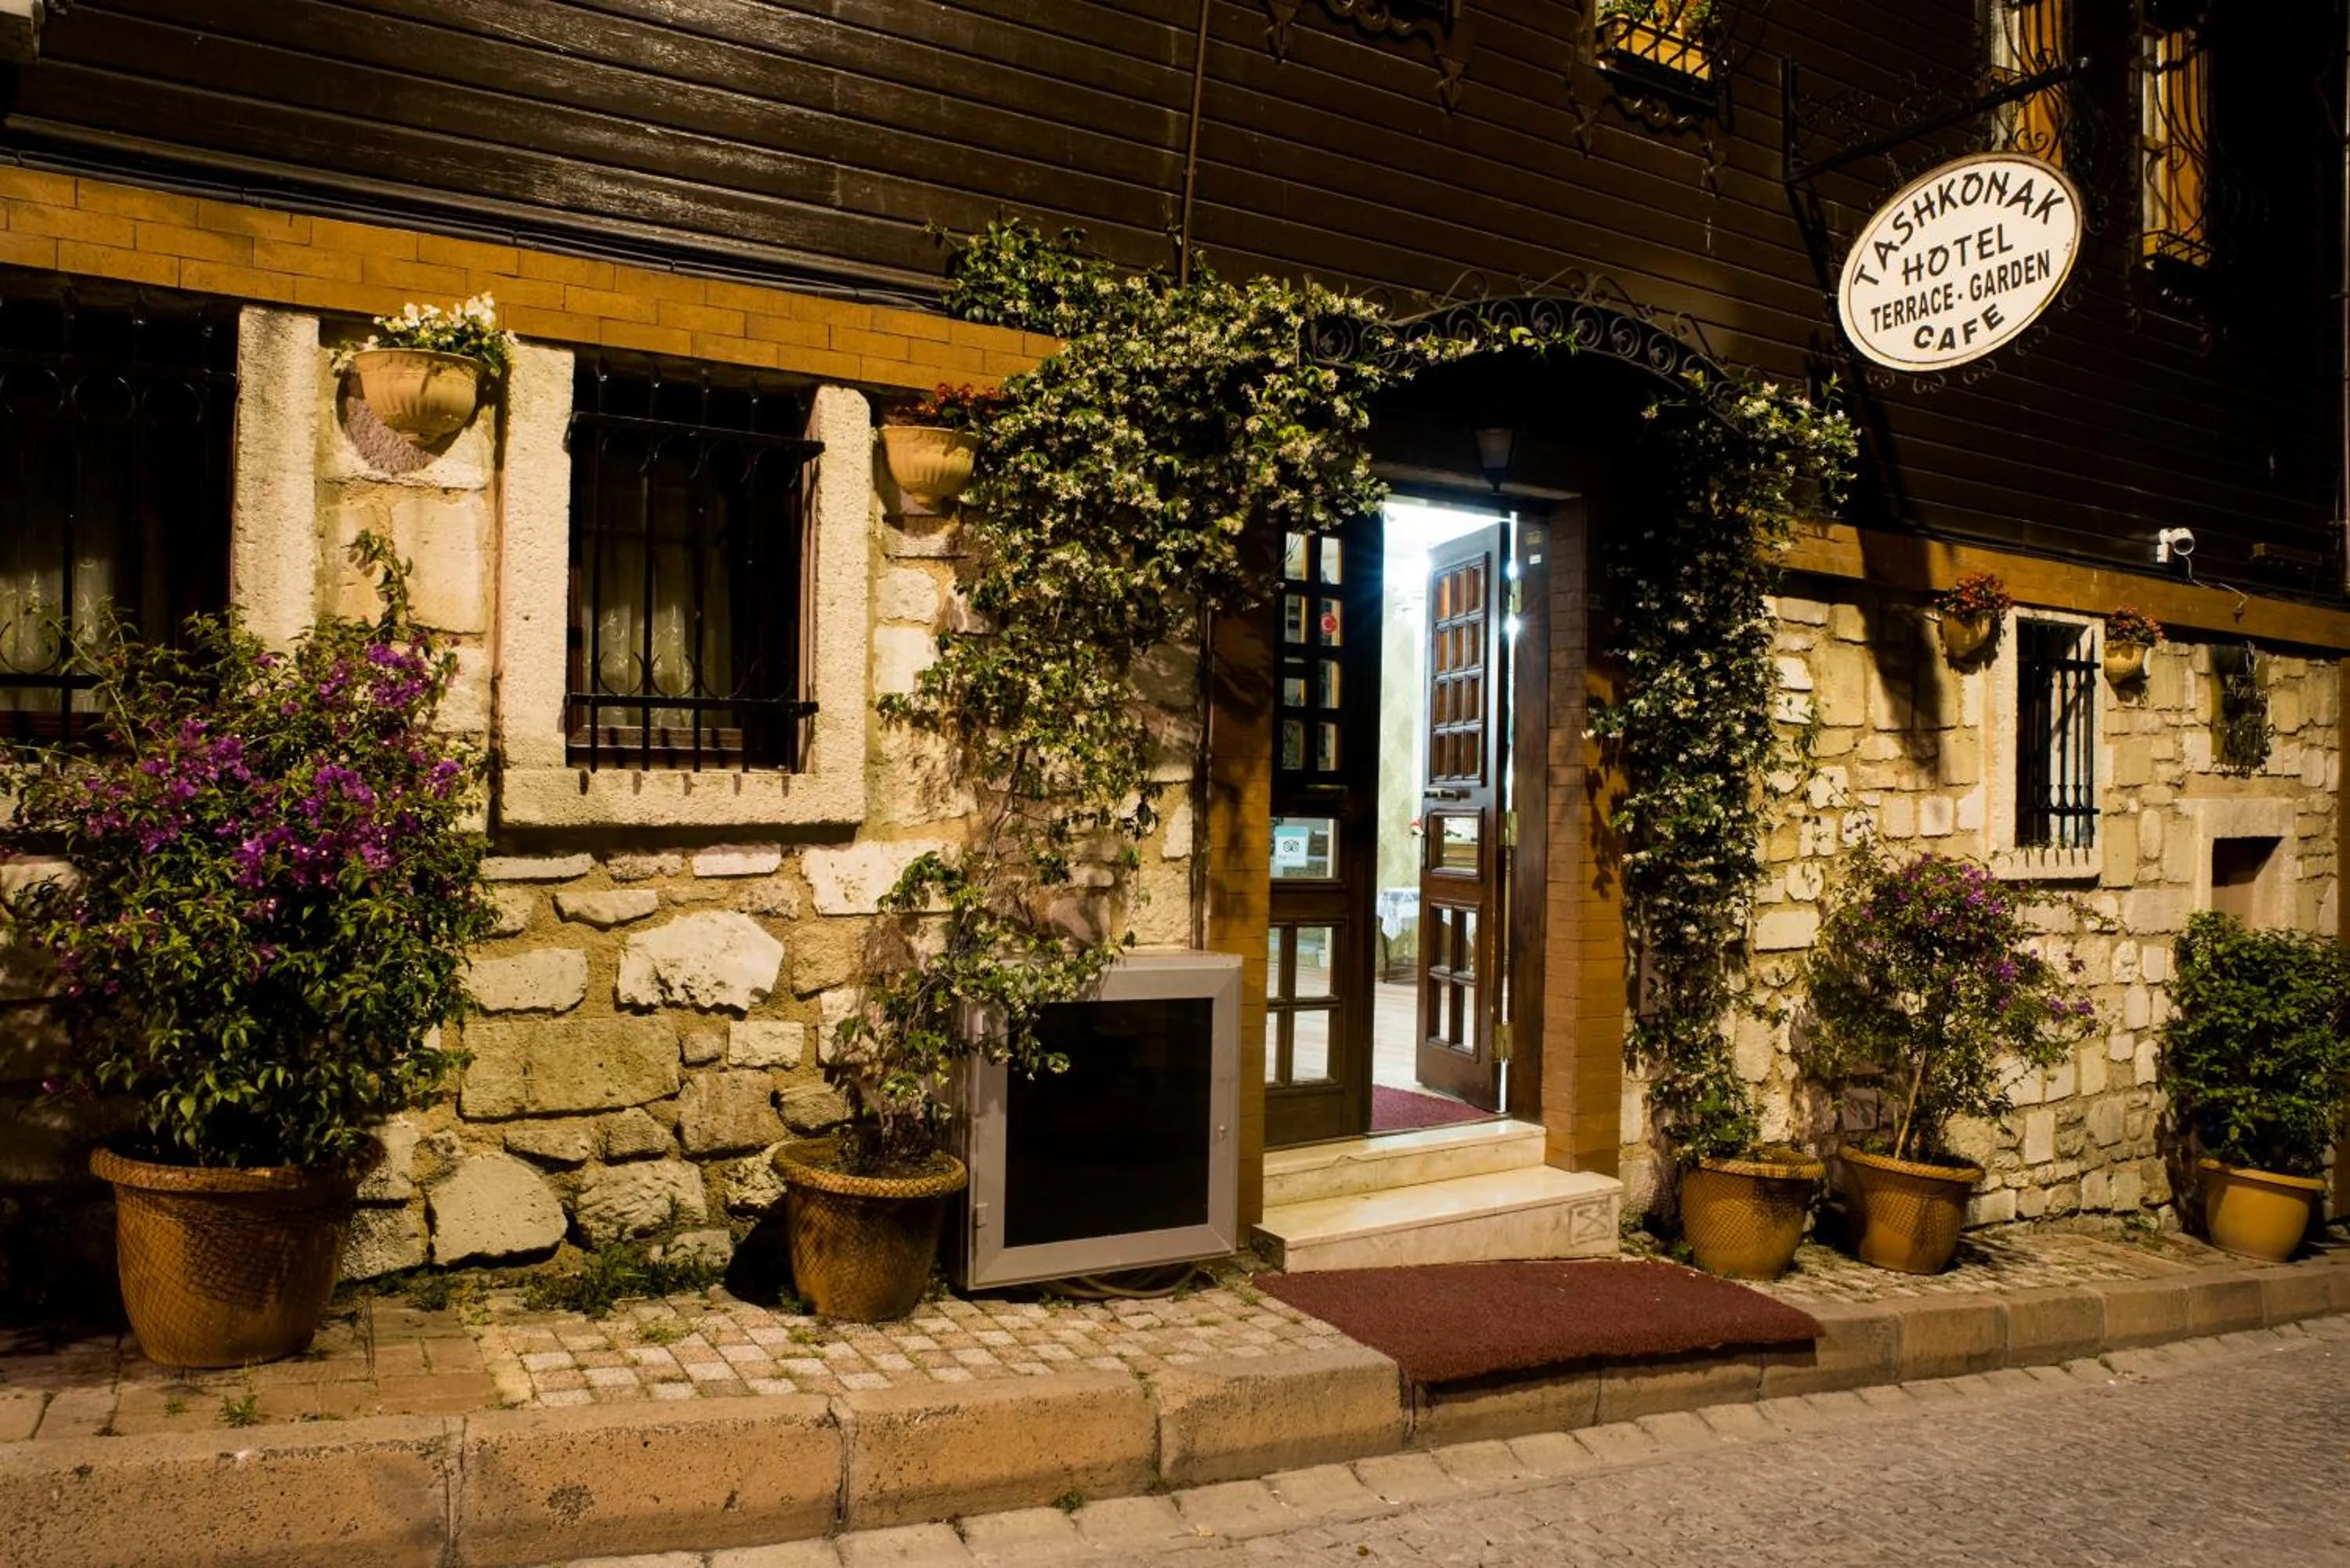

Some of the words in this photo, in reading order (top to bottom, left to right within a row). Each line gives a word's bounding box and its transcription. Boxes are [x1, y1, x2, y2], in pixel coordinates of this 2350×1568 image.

[1853, 171, 2065, 286] TASHKONAK
[1902, 223, 2014, 286] HOTEL
[1913, 303, 2005, 352] CAFE
